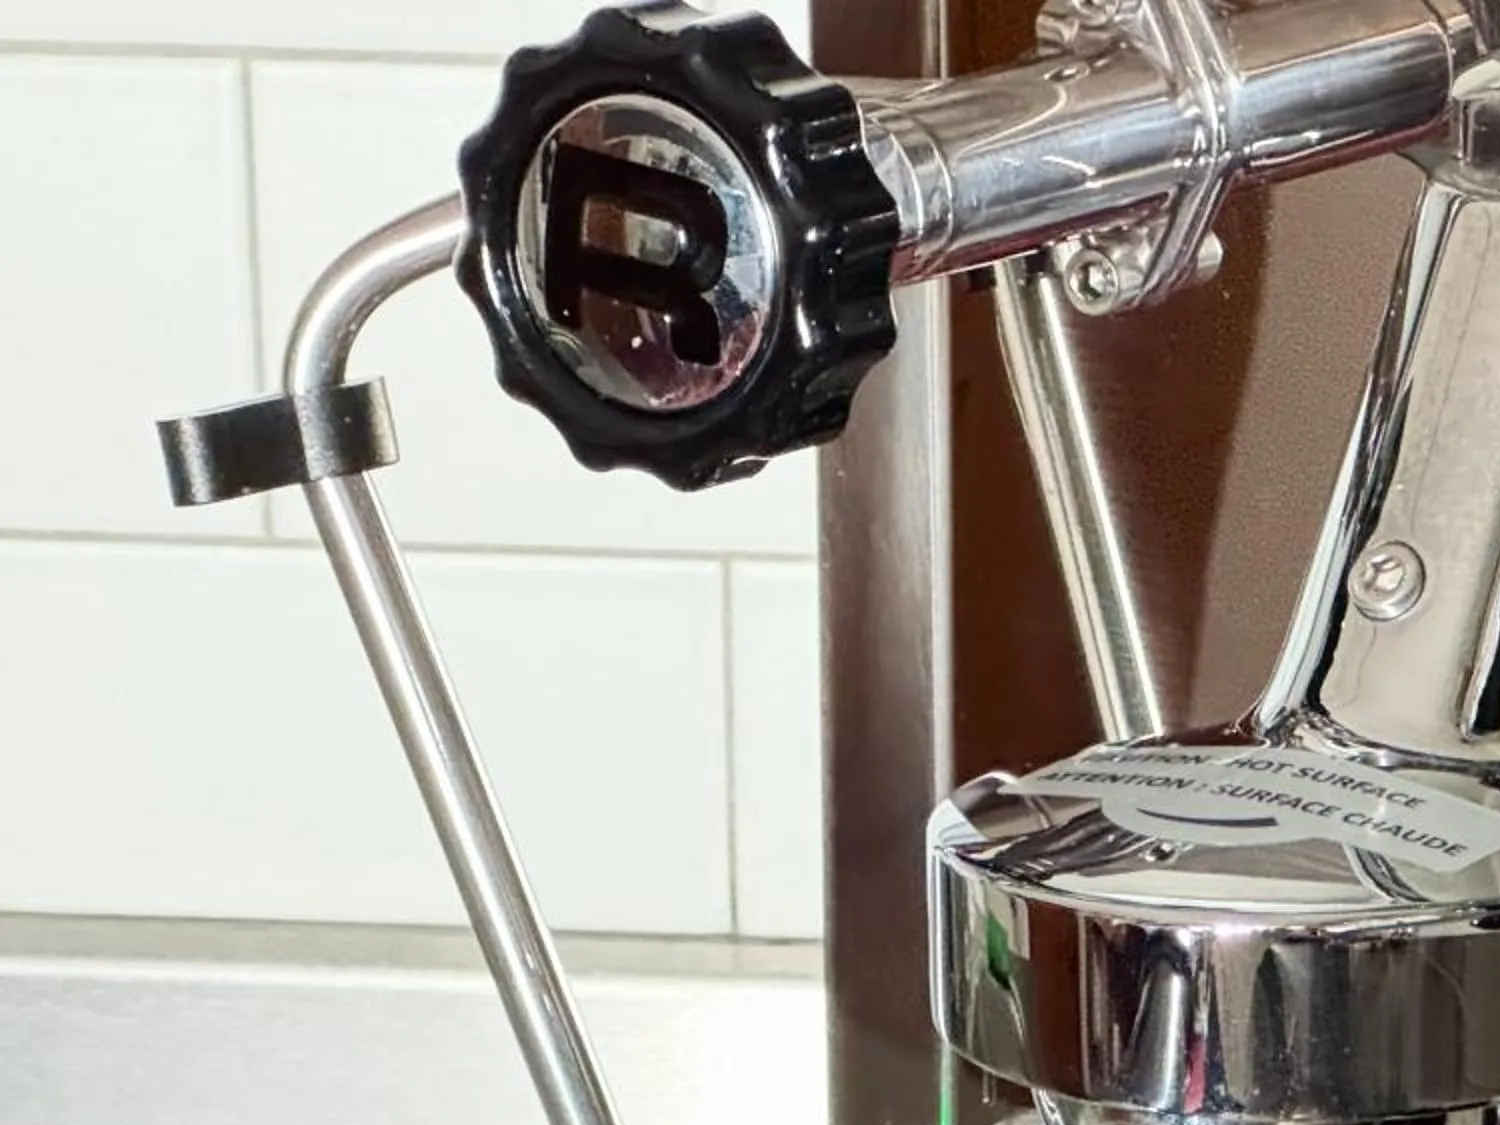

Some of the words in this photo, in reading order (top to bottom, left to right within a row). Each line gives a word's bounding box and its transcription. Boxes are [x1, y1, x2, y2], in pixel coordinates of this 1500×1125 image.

[545, 141, 728, 366] R
[1038, 772, 1195, 790] ATTENTION
[1210, 783, 1341, 818] SURFACE
[1342, 812, 1468, 857] CHAUDE
[1226, 757, 1293, 773] HOT
[1291, 766, 1425, 809] SURFACE
